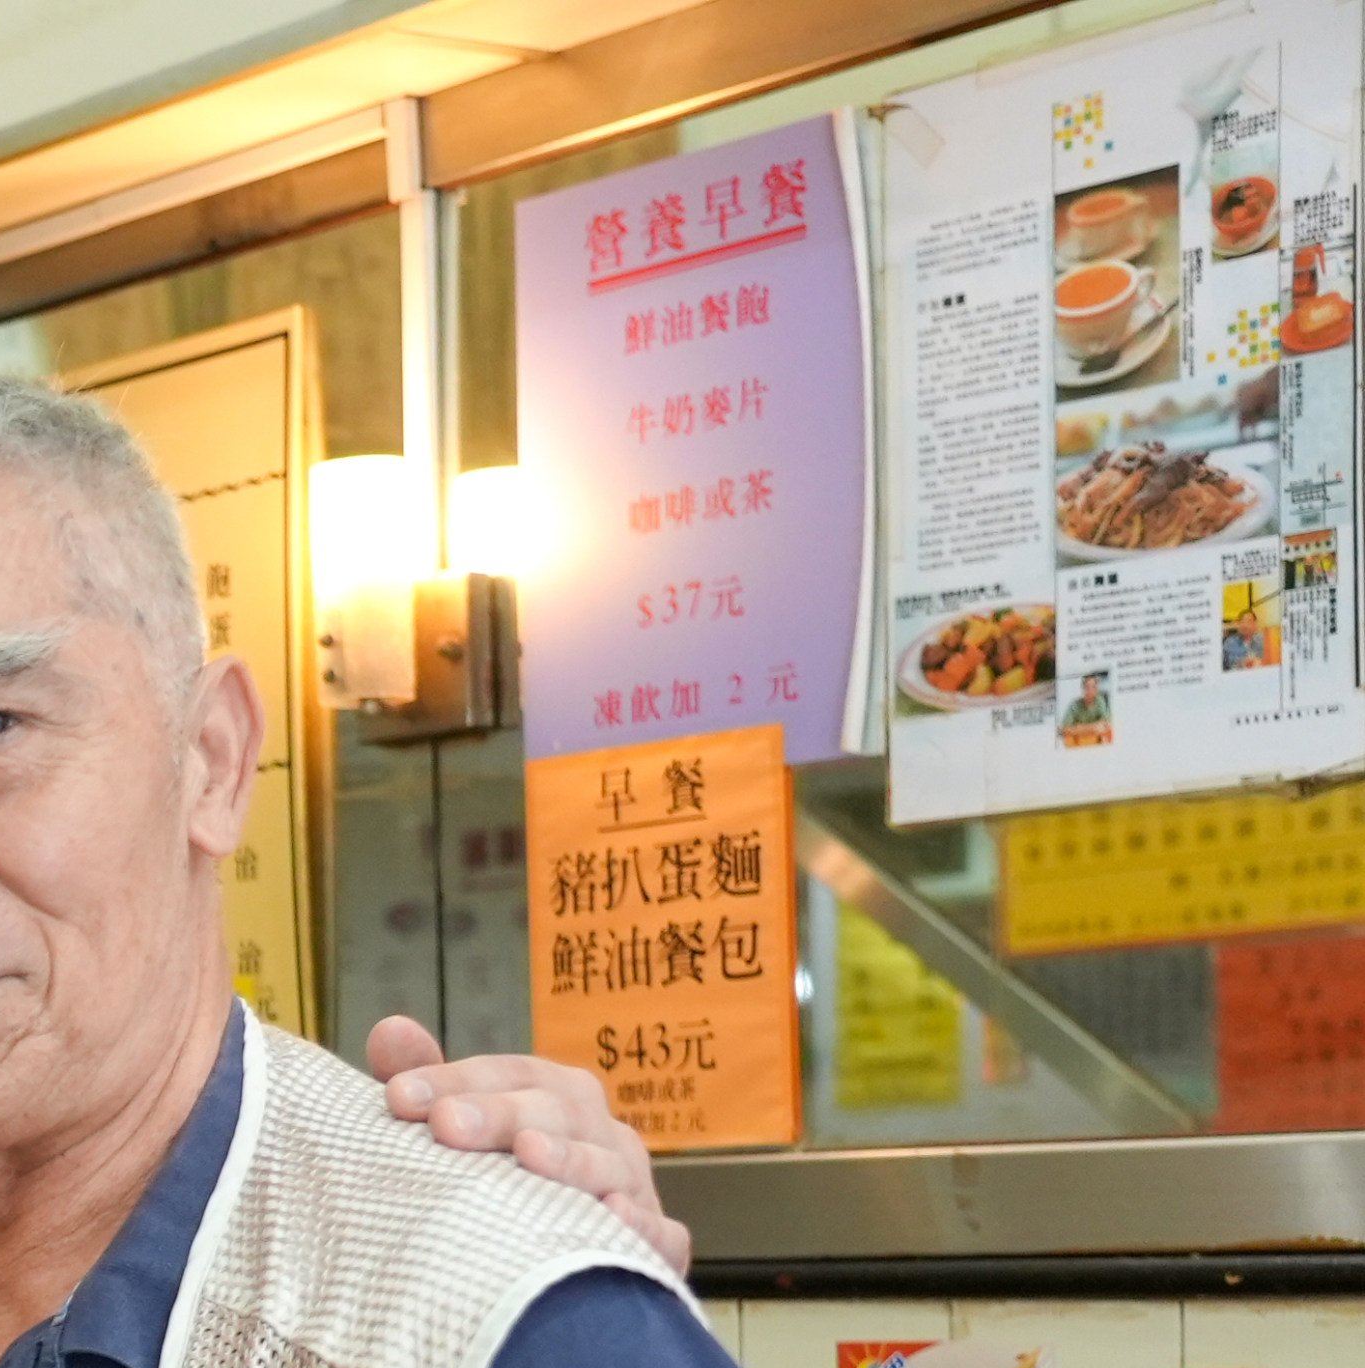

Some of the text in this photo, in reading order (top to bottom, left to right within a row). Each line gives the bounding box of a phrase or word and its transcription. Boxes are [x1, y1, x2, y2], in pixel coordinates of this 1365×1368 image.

[586, 158, 807, 272] 營養早餐
[625, 283, 772, 355] 鮮油餐飽
[628, 378, 770, 445] 牛奶麥片
[630, 470, 773, 535] 咖啡或茶
[598, 757, 706, 822] 早餐
[548, 830, 763, 918] 豬扒蛋麵
[551, 915, 763, 997] 鮮油餐包
[596, 1018, 717, 1072] $43元
